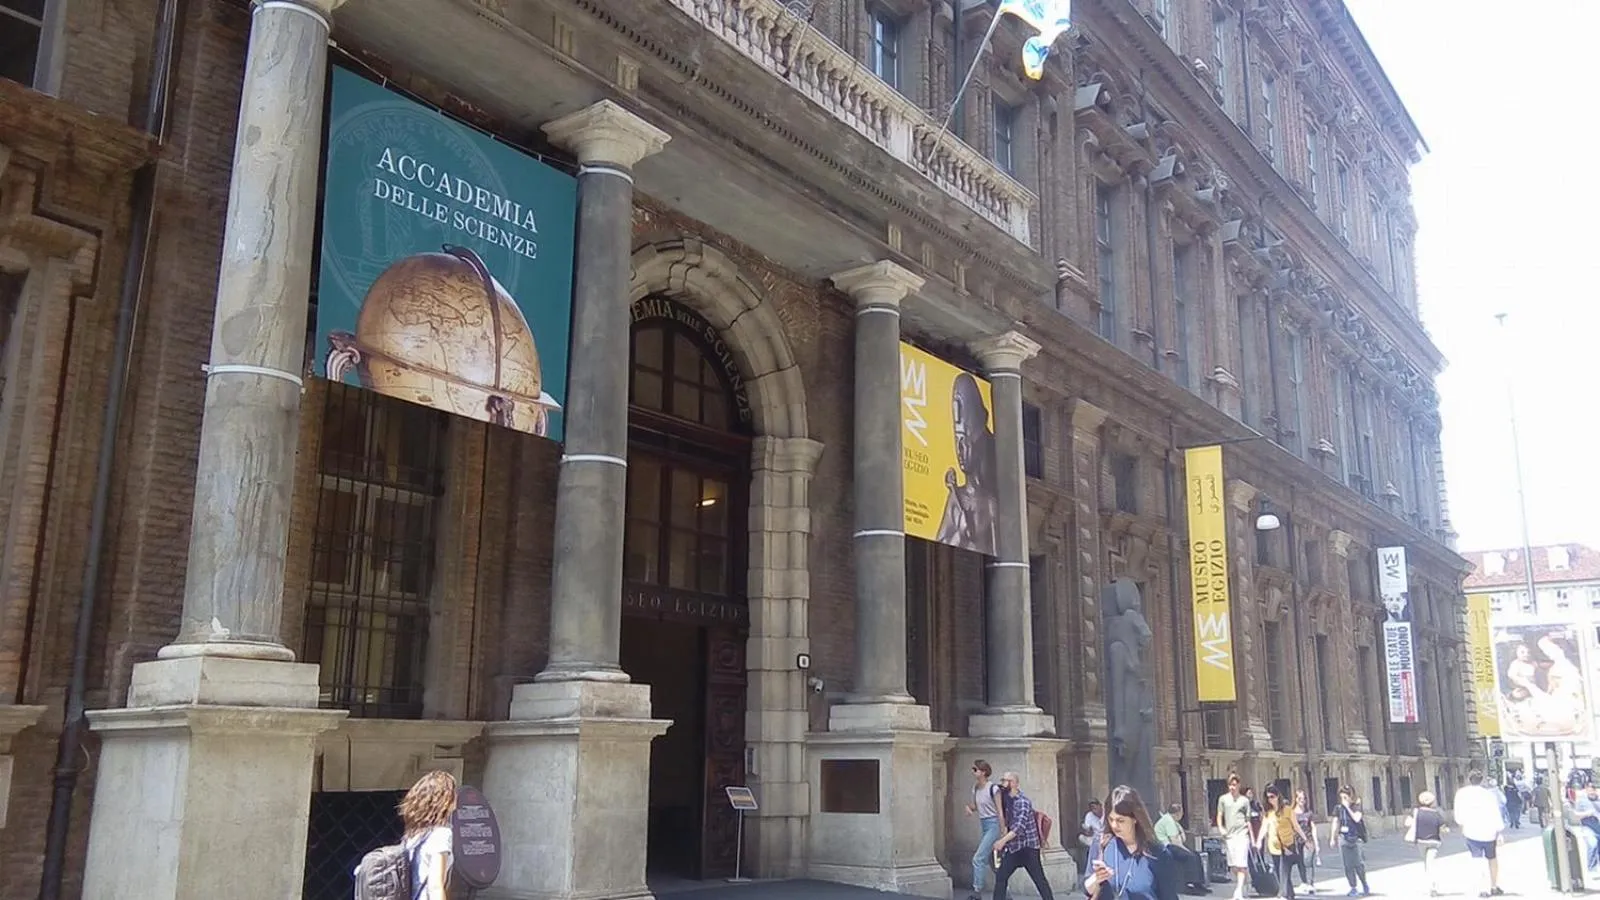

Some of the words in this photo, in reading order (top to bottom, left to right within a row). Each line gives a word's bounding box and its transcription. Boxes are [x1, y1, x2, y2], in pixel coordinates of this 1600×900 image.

[376, 147, 538, 233] ACCADEMIA
[373, 178, 448, 224] DELLE
[453, 211, 538, 259] SCIENZE
[704, 326, 752, 422] SCIENZE
[1193, 541, 1209, 604] MUSEO
[1210, 540, 1225, 603] EGIZIO
[628, 592, 660, 608] SEO
[675, 597, 740, 619] EGIZIO
[1387, 627, 1399, 657] STATUE
[1399, 627, 1411, 670] MUOIONO
[1389, 662, 1399, 671] LE
[1390, 674, 1401, 699] ANCHE
[1475, 648, 1484, 683] MUSEO
